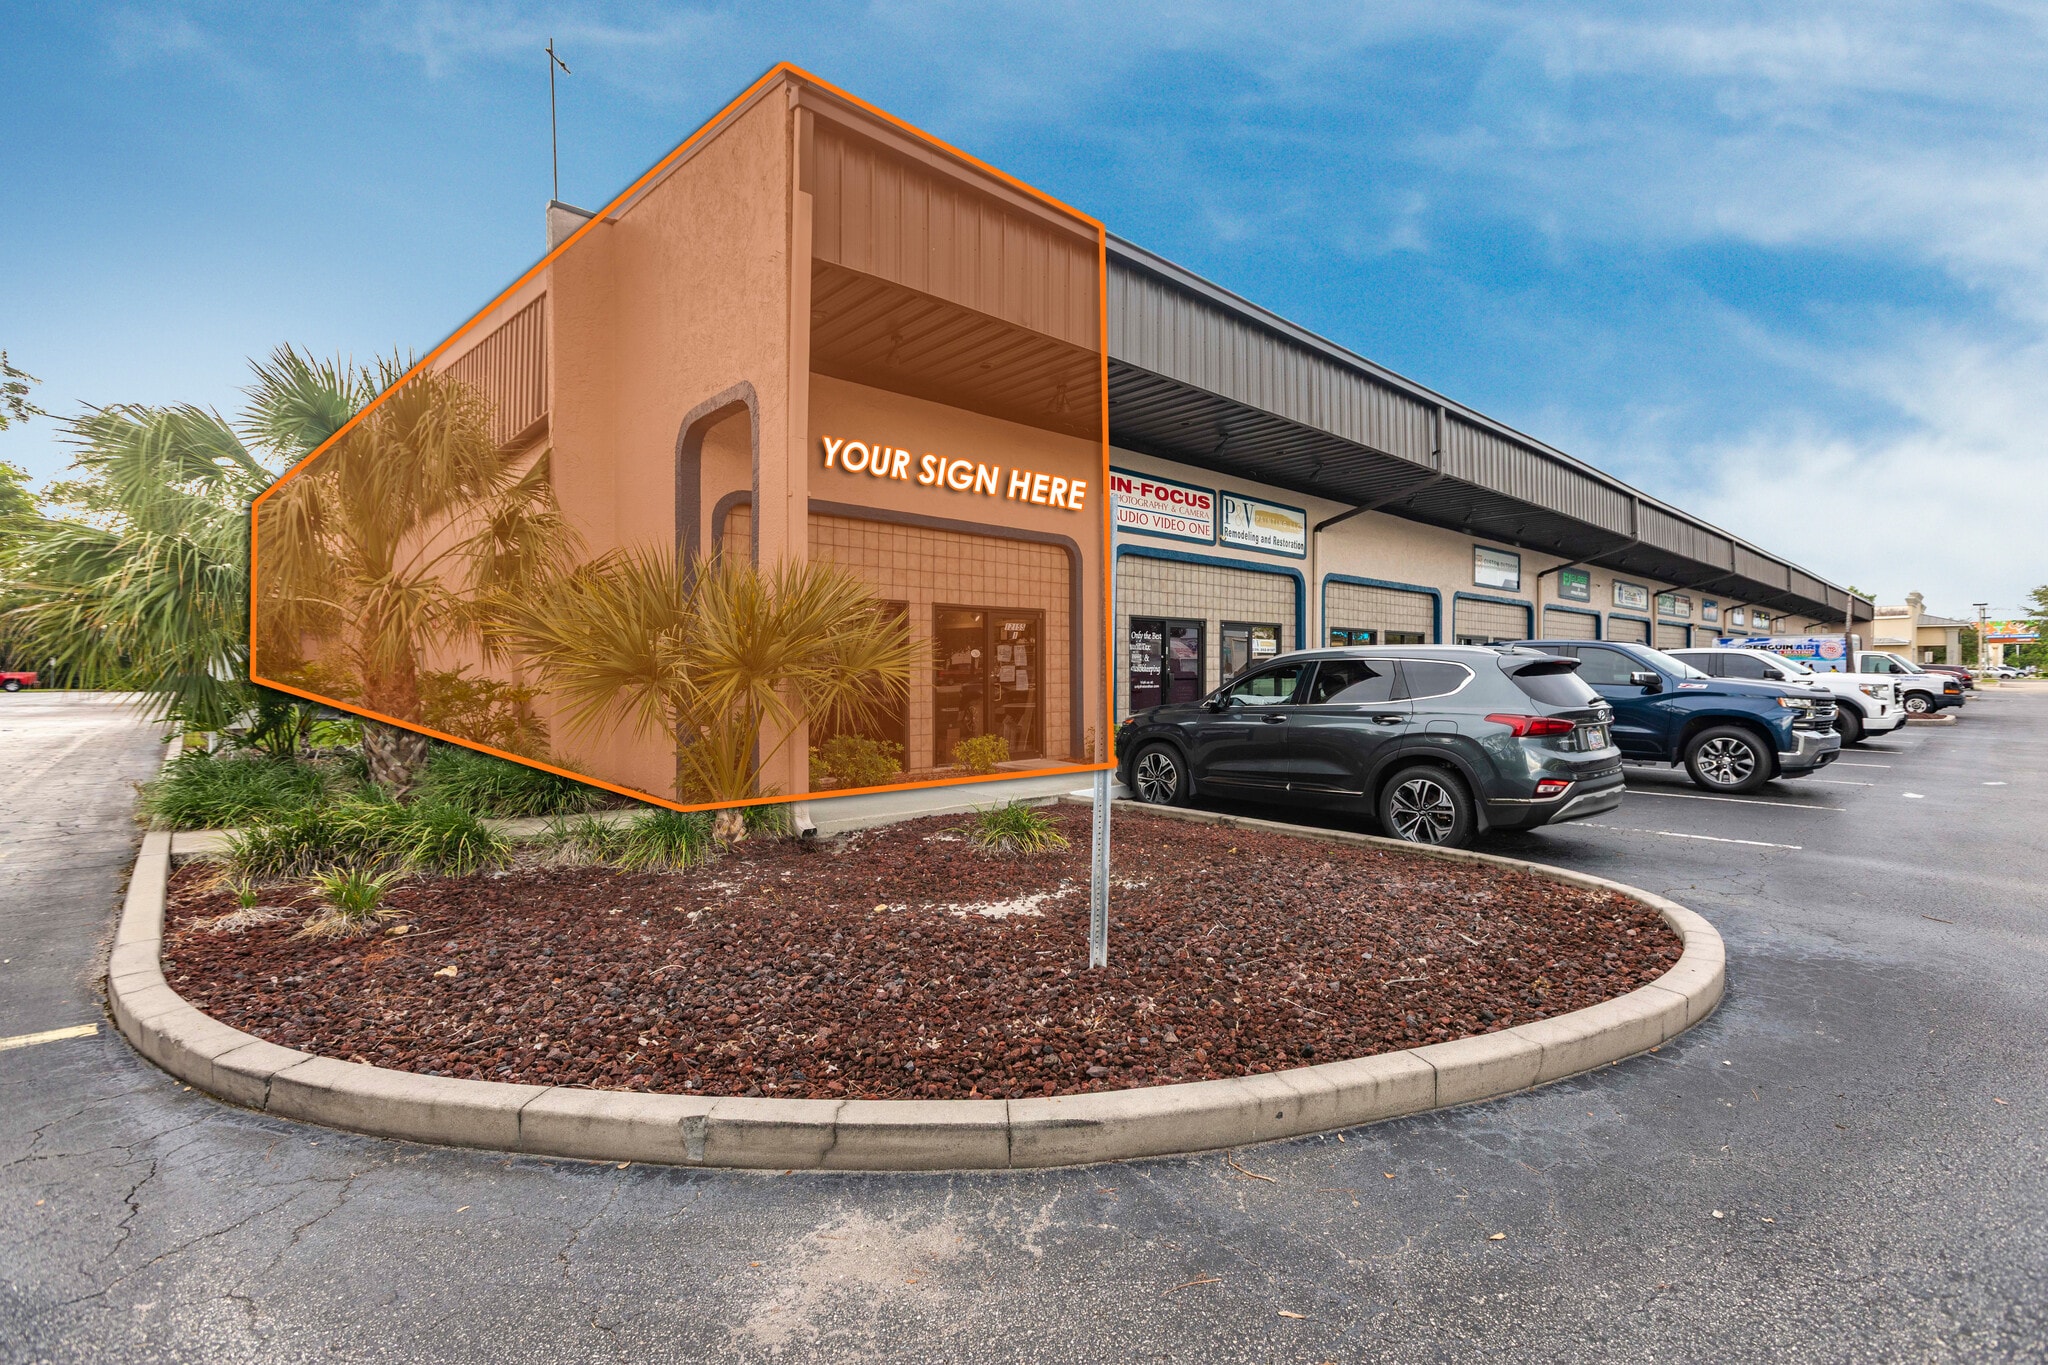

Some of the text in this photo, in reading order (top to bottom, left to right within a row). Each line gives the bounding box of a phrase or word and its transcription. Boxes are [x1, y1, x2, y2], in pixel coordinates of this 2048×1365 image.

[1111, 475, 1210, 510] IN-FOCUS
[1117, 493, 1210, 520] HOTOGRAPHY & CAMERA
[1152, 515, 1186, 532] VIDEO
[1188, 522, 1210, 537] ONE
[1223, 526, 1304, 550] Remodeling and Restoration
[1131, 630, 1162, 642] Only the Best
